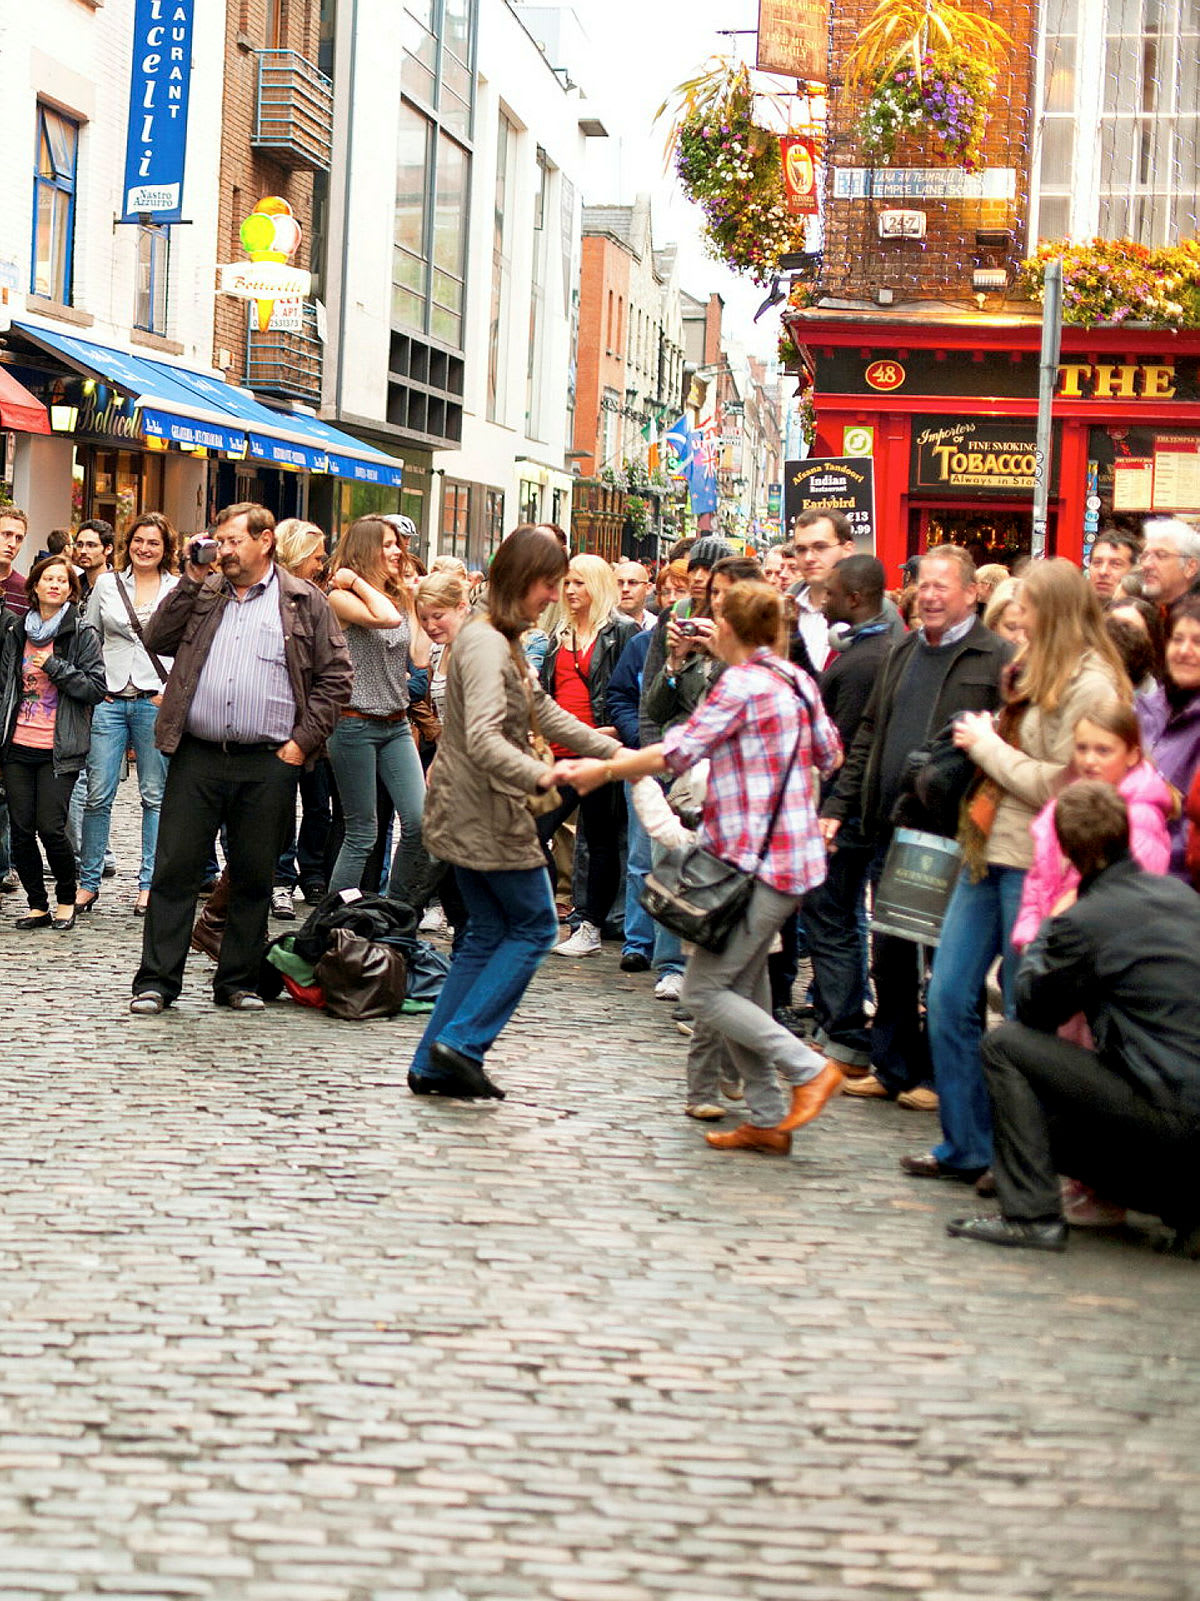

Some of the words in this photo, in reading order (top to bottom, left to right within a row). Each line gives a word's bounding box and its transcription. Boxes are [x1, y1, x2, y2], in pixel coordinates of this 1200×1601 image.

[168, 0, 187, 118] AURANT
[140, 188, 173, 200] Nastro
[873, 185, 912, 194] TEMPLE
[916, 185, 944, 195] LANE
[132, 197, 174, 208] Azzurro
[870, 364, 897, 382] 48
[1058, 364, 1176, 398] THE
[916, 422, 976, 446] Importers
[952, 435, 965, 444] OF
[968, 440, 991, 451] FINE
[993, 441, 1037, 452] SMOKING
[931, 445, 1037, 480] TOBACCO
[792, 465, 822, 486] Afsana
[824, 462, 865, 484] Tandoori
[809, 474, 847, 486] Indian
[952, 474, 992, 486] Always
[998, 475, 1009, 485] in
[802, 496, 856, 511] Earlybird
[846, 511, 869, 523] €13
